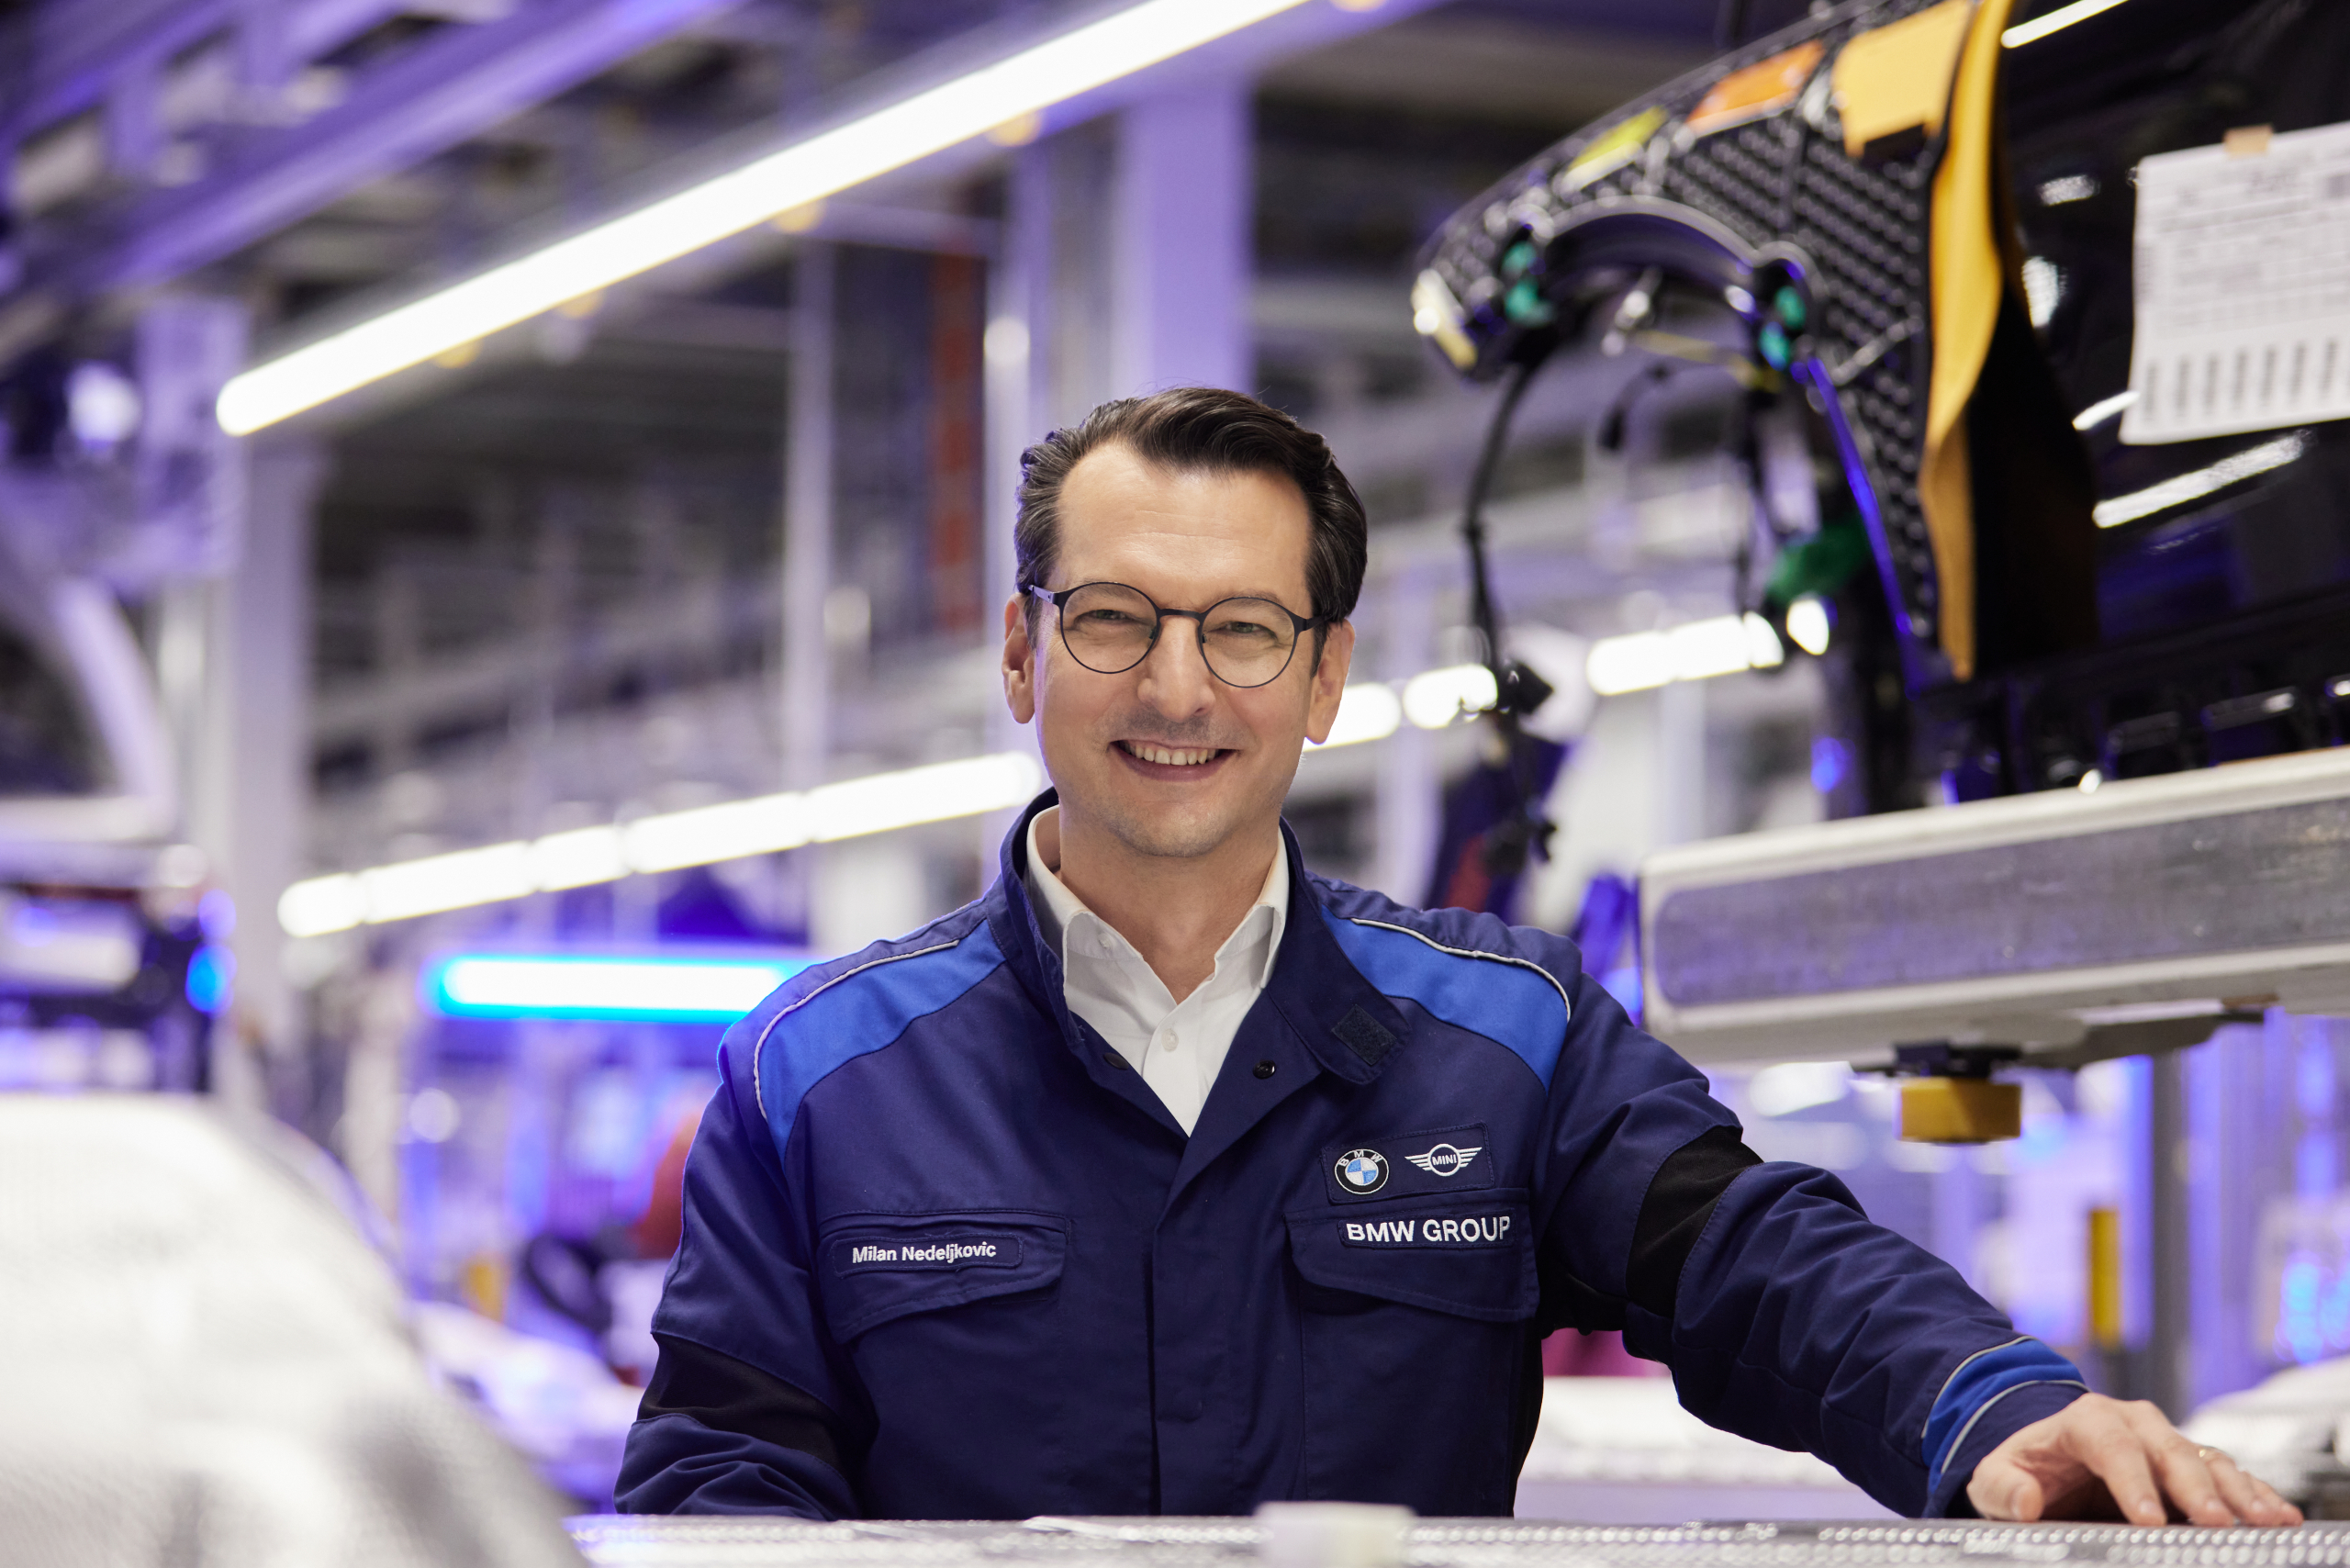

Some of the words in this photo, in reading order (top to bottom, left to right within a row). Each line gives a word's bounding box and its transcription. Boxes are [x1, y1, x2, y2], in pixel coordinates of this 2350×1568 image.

[1338, 1149, 1383, 1167] BMW
[1432, 1154, 1458, 1166] MINI
[1346, 1220, 1416, 1242] BMW
[1423, 1216, 1511, 1243] GROUP
[852, 1246, 898, 1264] Milan
[901, 1241, 997, 1264] Nedeljkovic
